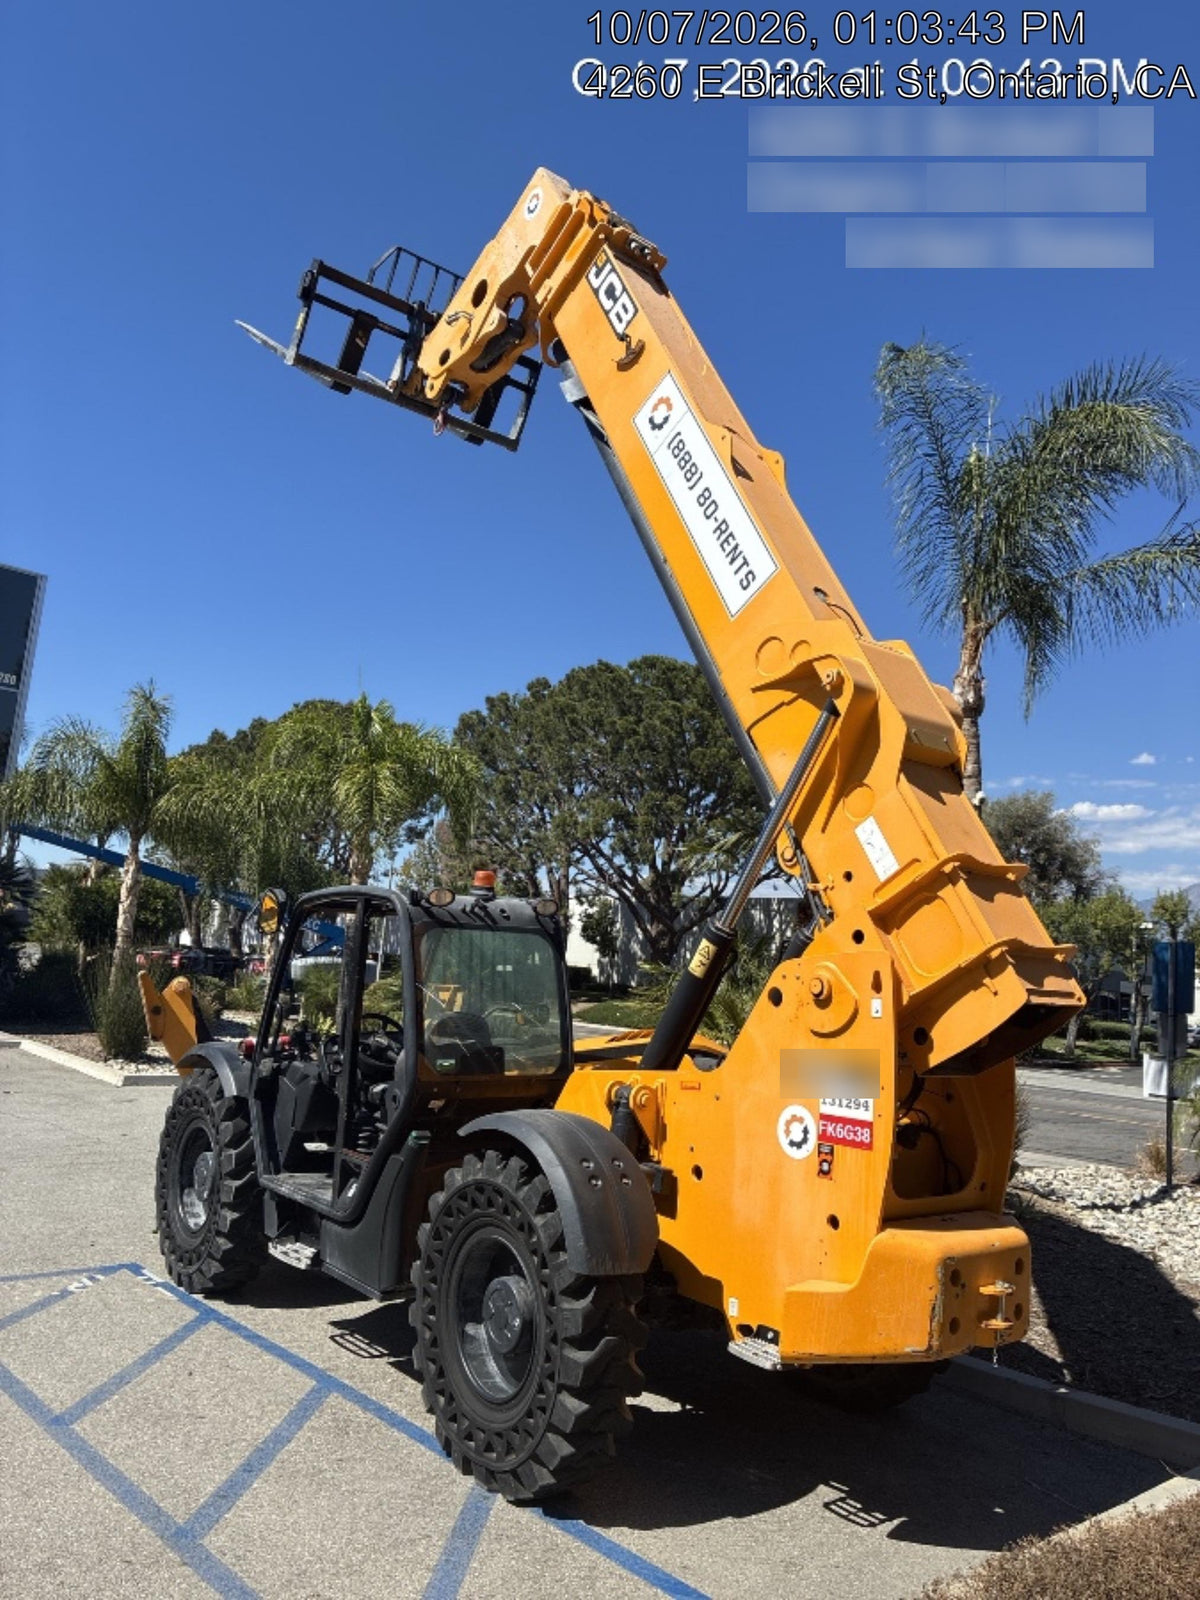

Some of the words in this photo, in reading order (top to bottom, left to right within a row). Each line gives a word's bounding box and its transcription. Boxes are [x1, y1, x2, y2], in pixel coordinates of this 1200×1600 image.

[587, 261, 636, 335] JCB
[667, 431, 704, 491] (888)
[696, 487, 757, 591] 80-RENTS
[819, 1120, 871, 1144] FK6G38
